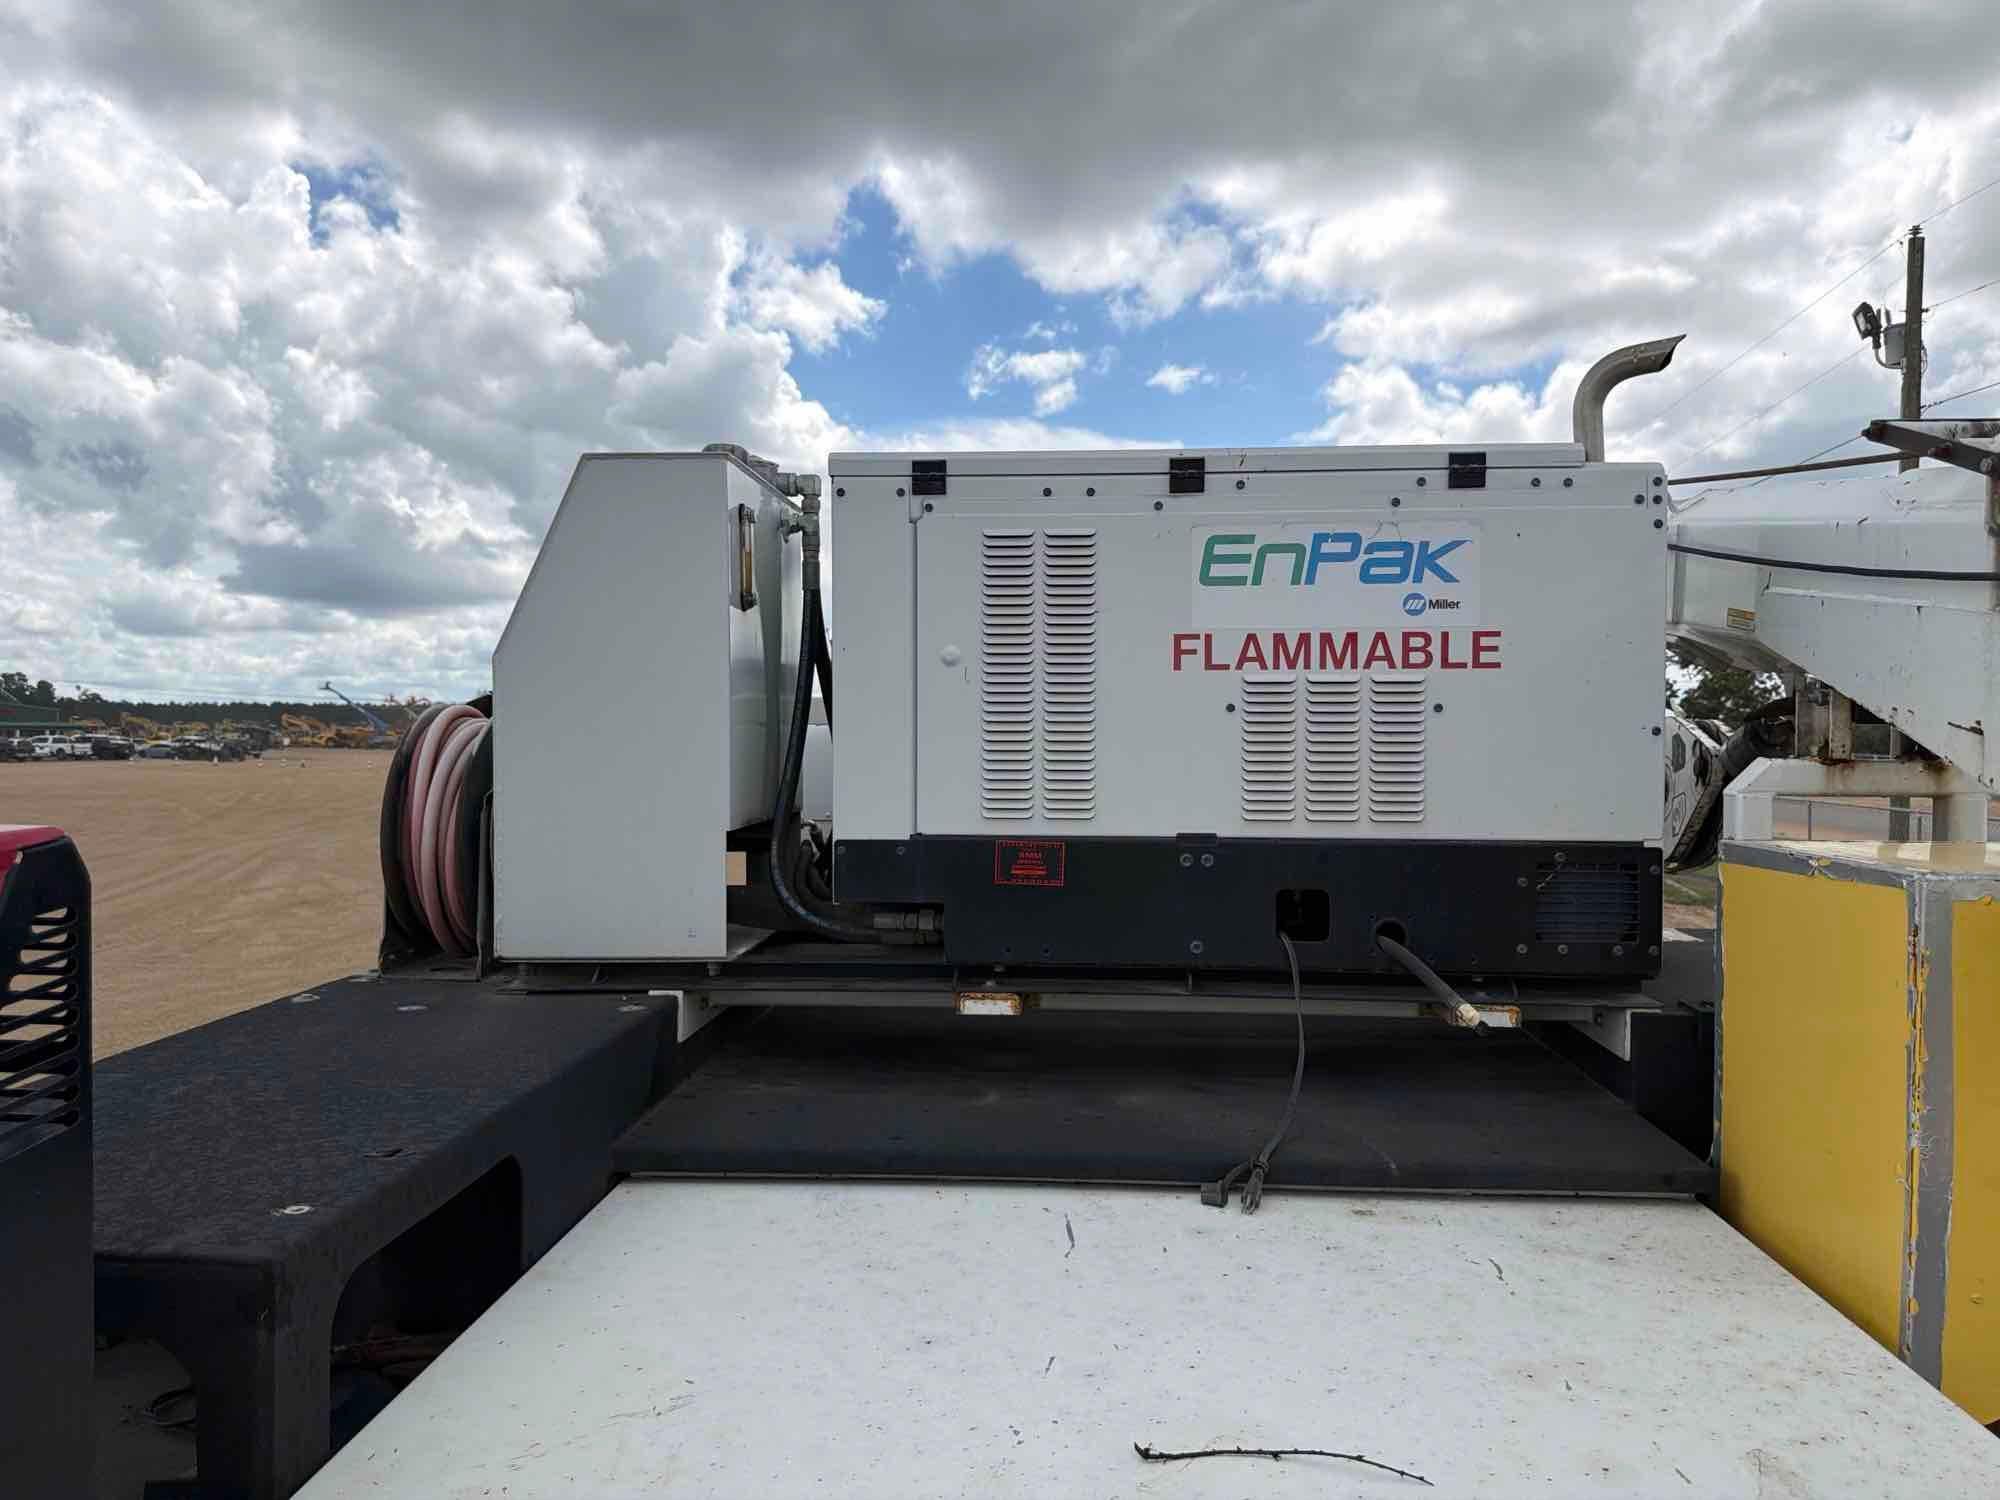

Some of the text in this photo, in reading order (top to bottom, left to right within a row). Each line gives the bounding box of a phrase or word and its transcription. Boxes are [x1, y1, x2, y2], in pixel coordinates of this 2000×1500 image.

[1199, 532, 1473, 586] EnPak
[1428, 599, 1461, 610] Miller
[1172, 630, 1504, 671] FLAMMABLE
